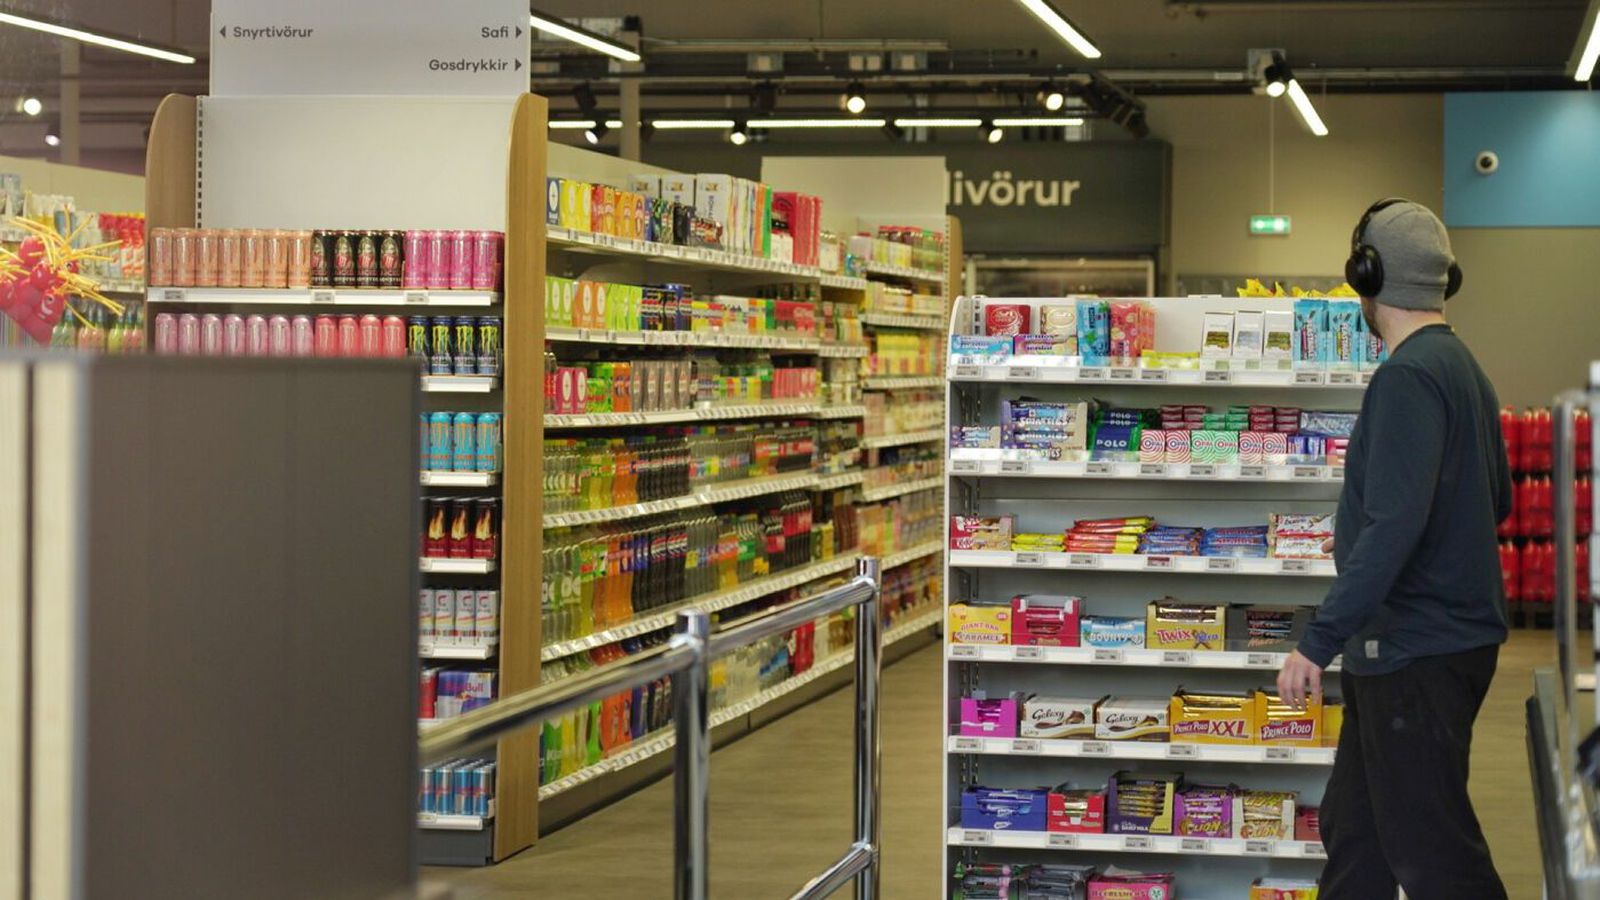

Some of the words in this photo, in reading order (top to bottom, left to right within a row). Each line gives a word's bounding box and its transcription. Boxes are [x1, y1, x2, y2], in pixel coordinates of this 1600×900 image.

[233, 26, 313, 40] Snyrtivörur
[481, 26, 509, 38] Safi
[428, 59, 508, 73] Gosdrykkir
[1096, 439, 1127, 448] POLO
[1032, 708, 1065, 721] Galaxy
[1105, 713, 1138, 725] Galaxy
[1209, 720, 1249, 738] XXL
